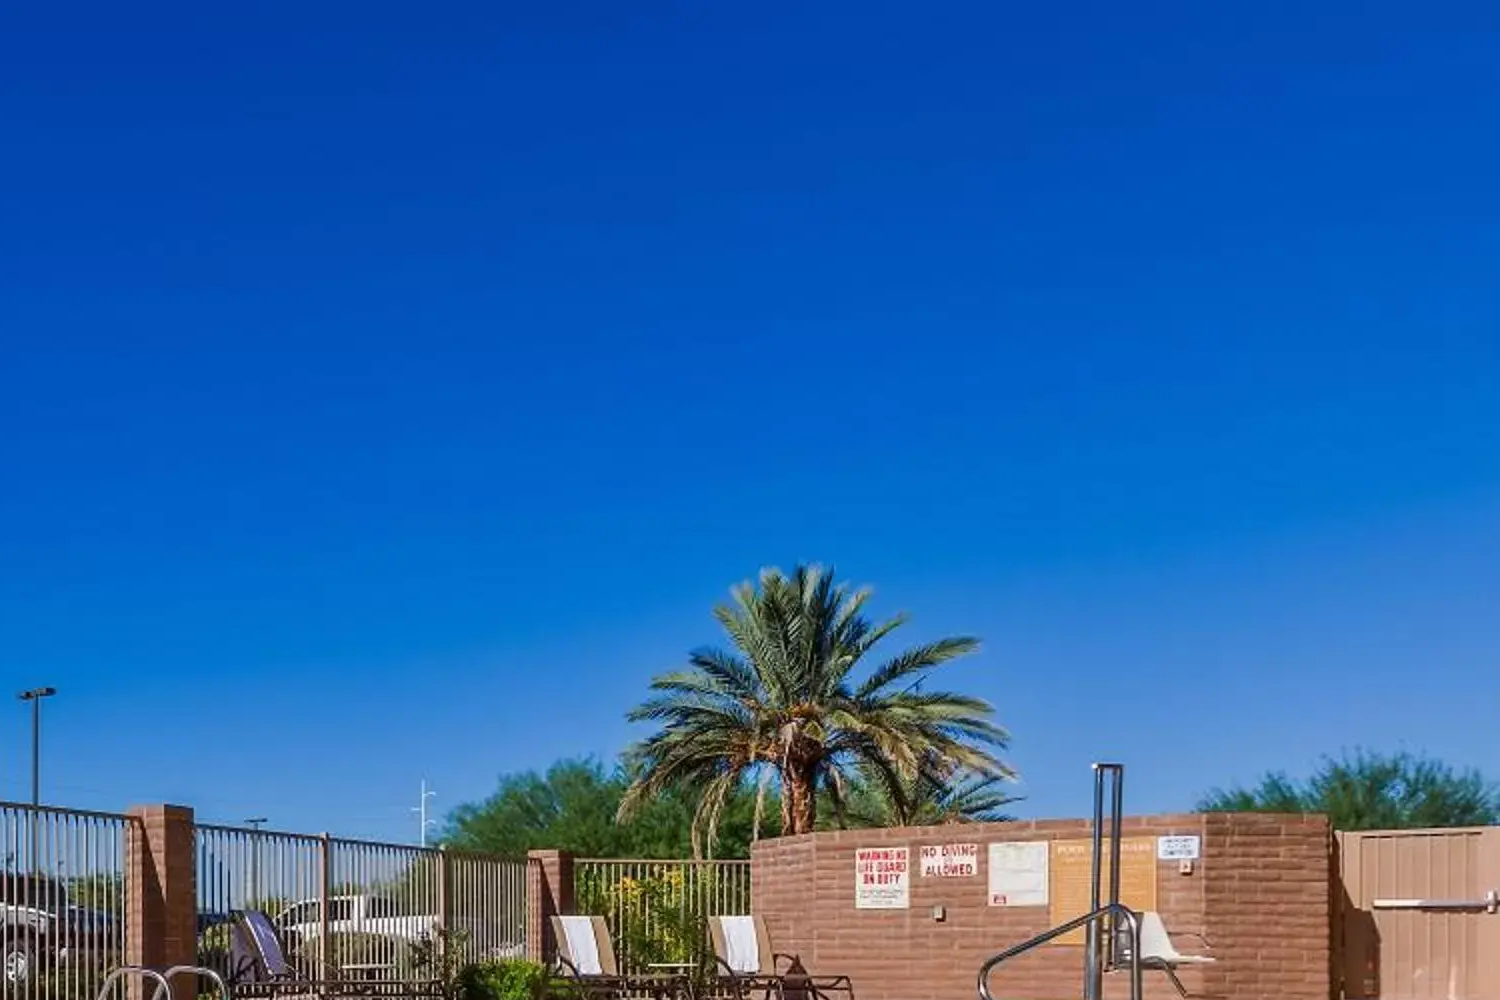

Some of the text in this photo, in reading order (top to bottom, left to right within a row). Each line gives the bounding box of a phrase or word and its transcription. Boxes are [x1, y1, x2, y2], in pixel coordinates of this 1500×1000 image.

[921, 845, 977, 858] NO DIVING
[925, 863, 973, 877] ALLOWED
[863, 873, 901, 885] ON DUTY
